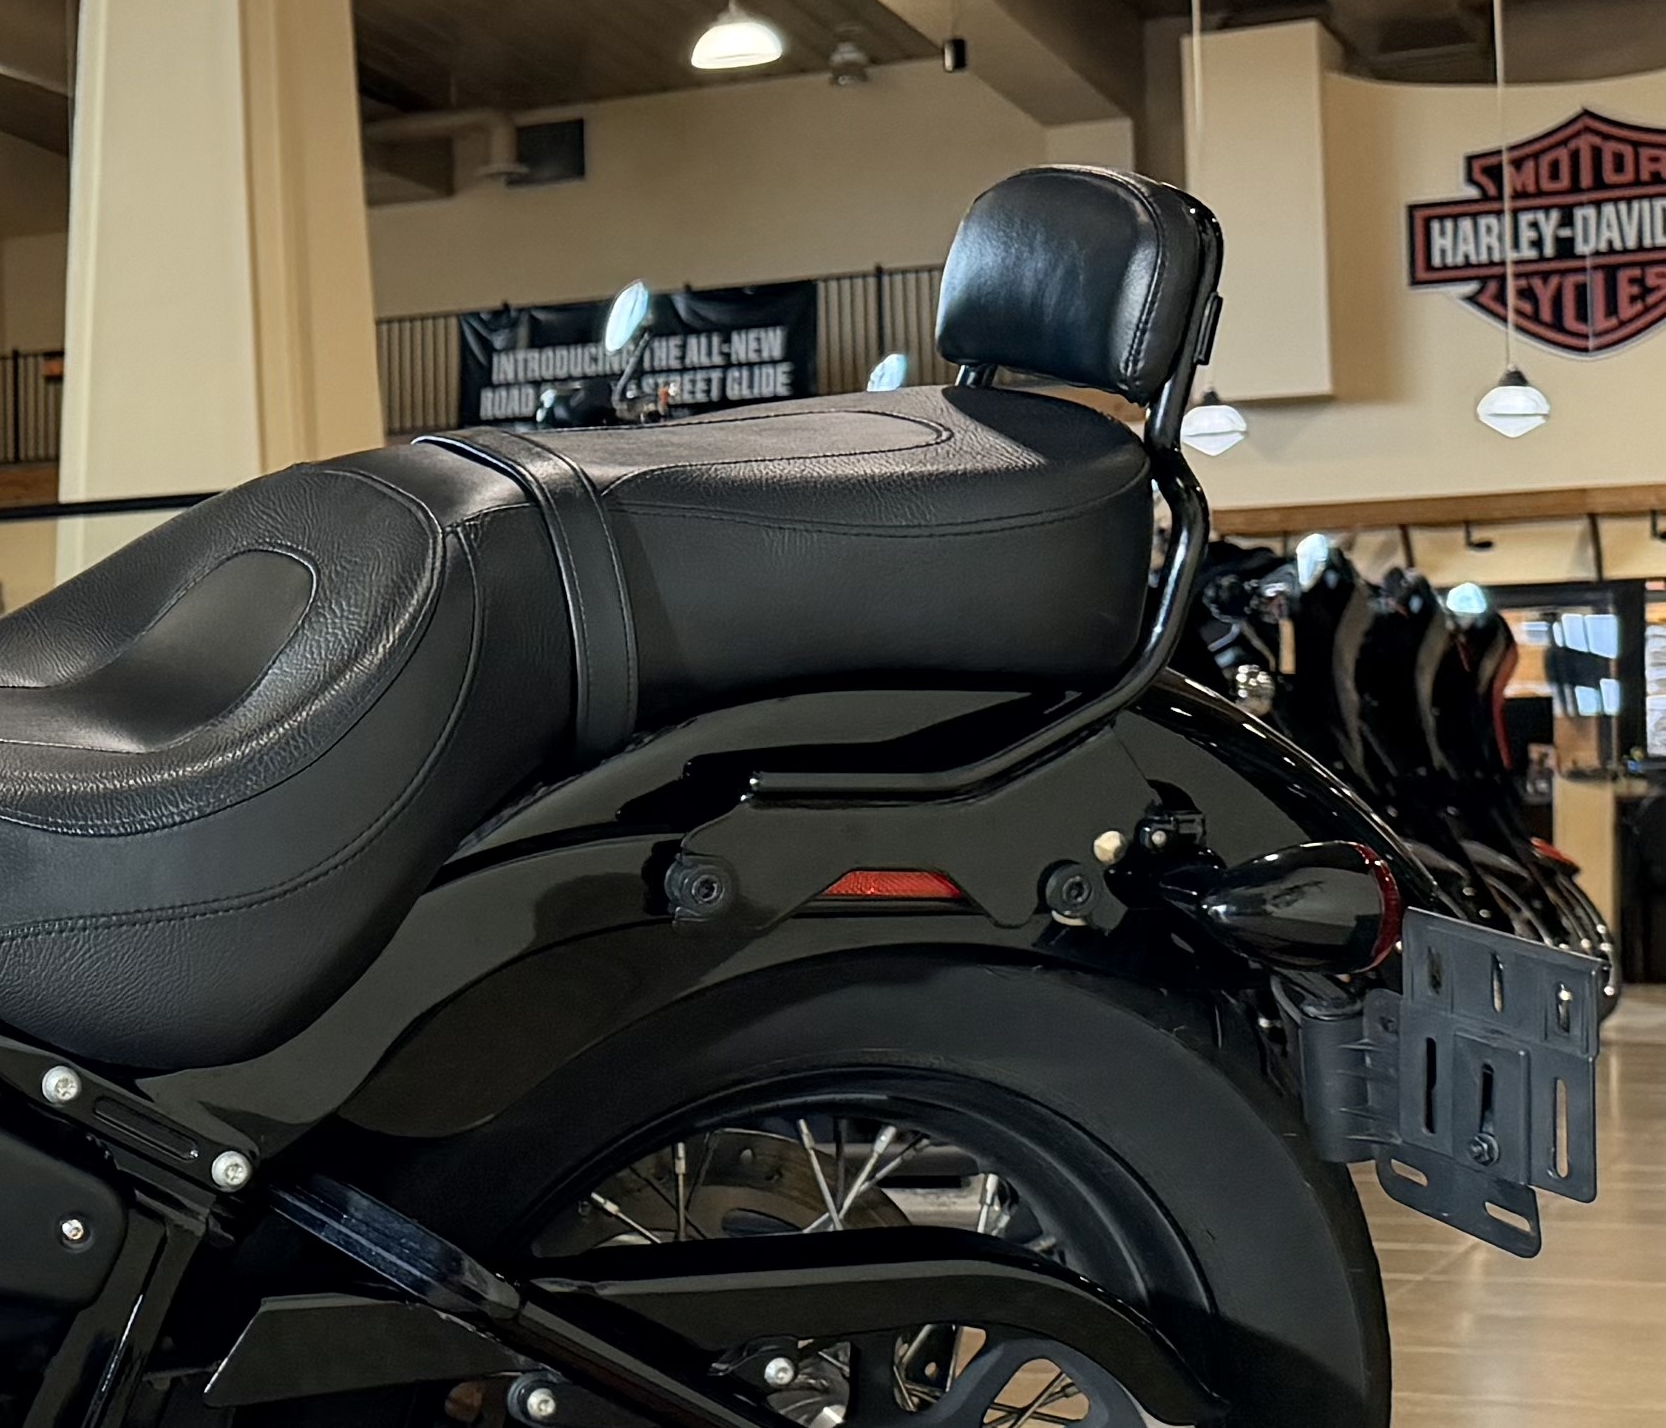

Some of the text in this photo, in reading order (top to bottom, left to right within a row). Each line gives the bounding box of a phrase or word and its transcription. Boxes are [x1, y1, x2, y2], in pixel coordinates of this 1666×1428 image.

[685, 326, 785, 367] ALL-NEW
[480, 384, 535, 421] ROAD
[726, 361, 794, 401] GLIDE
